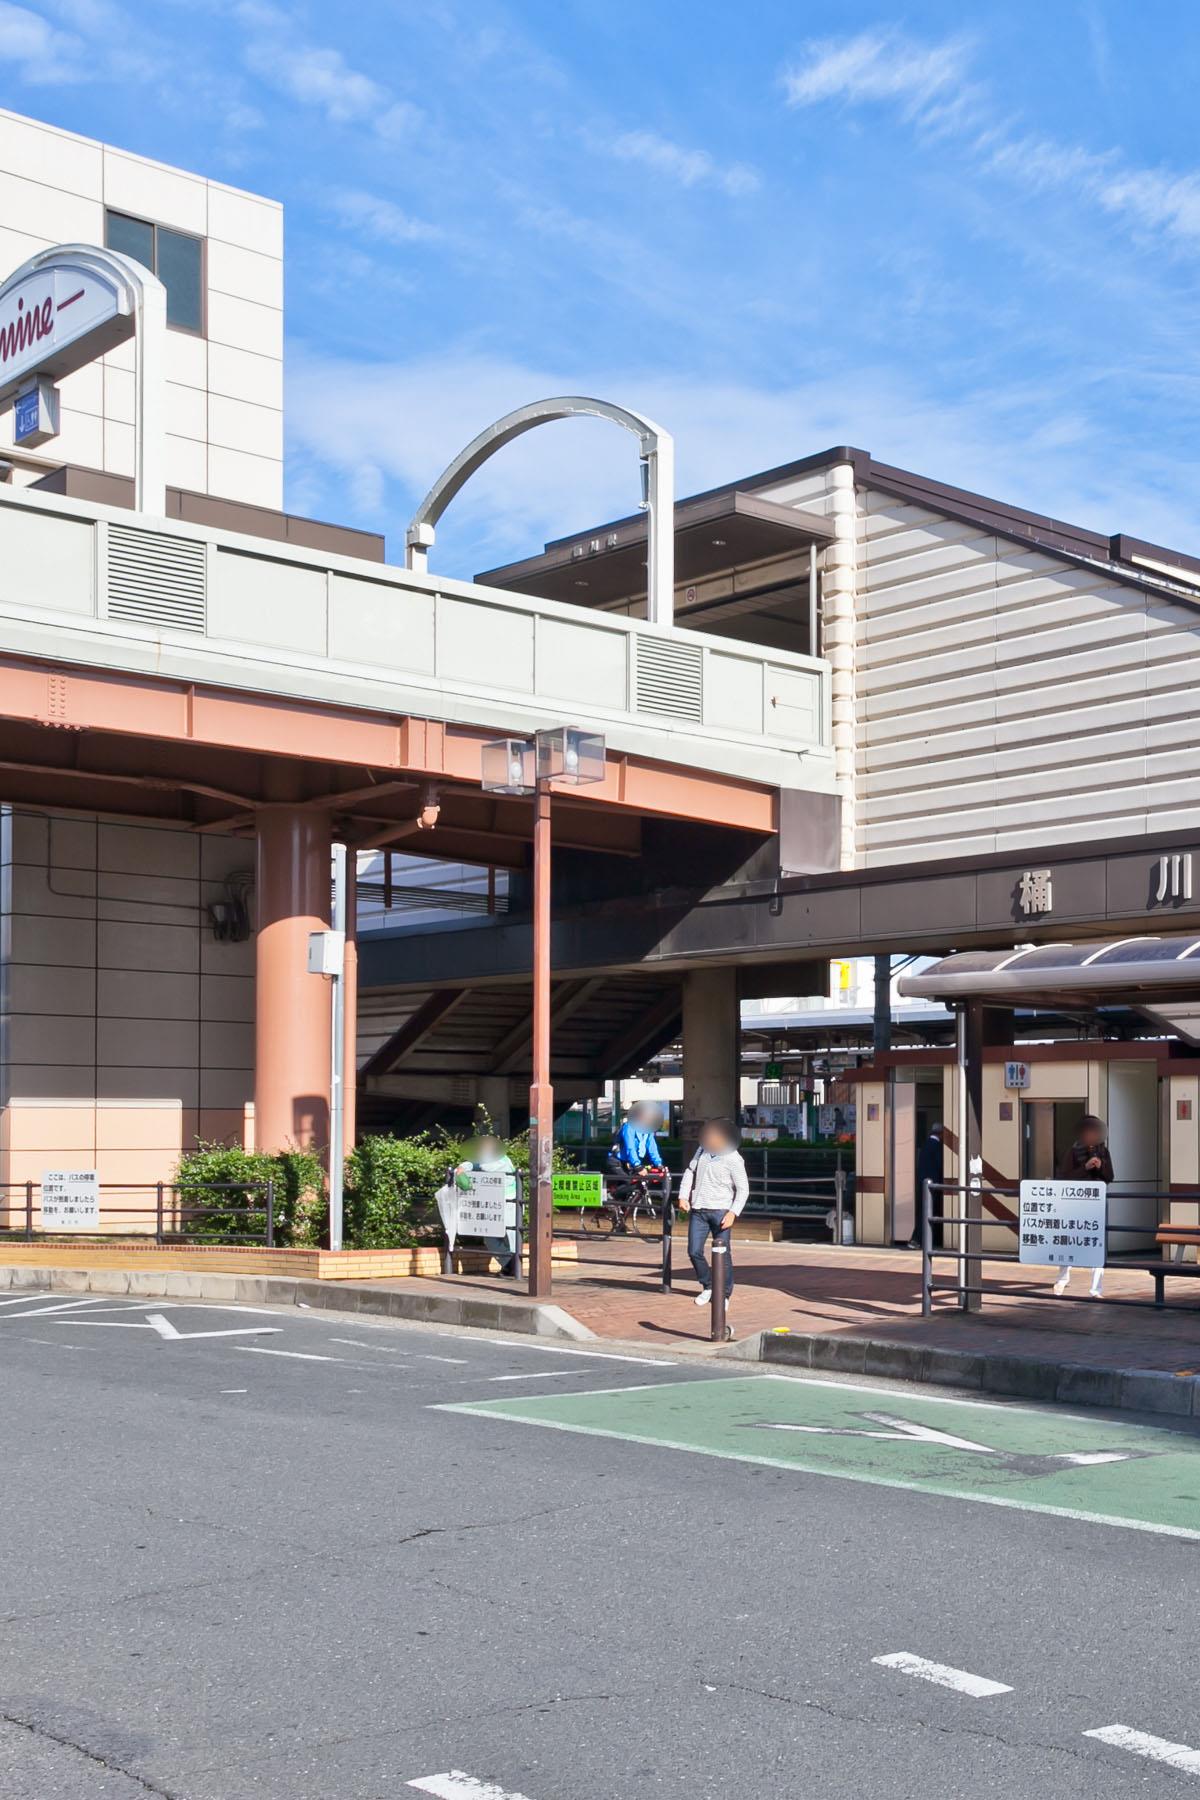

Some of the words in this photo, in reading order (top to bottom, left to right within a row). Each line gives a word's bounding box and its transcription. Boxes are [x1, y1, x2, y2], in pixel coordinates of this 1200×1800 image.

[1031, 1186, 1100, 1198] ここは、バスの停車
[1023, 1202, 1057, 1213] 位置です。
[1022, 1217, 1099, 1230] バスが到着しましたら
